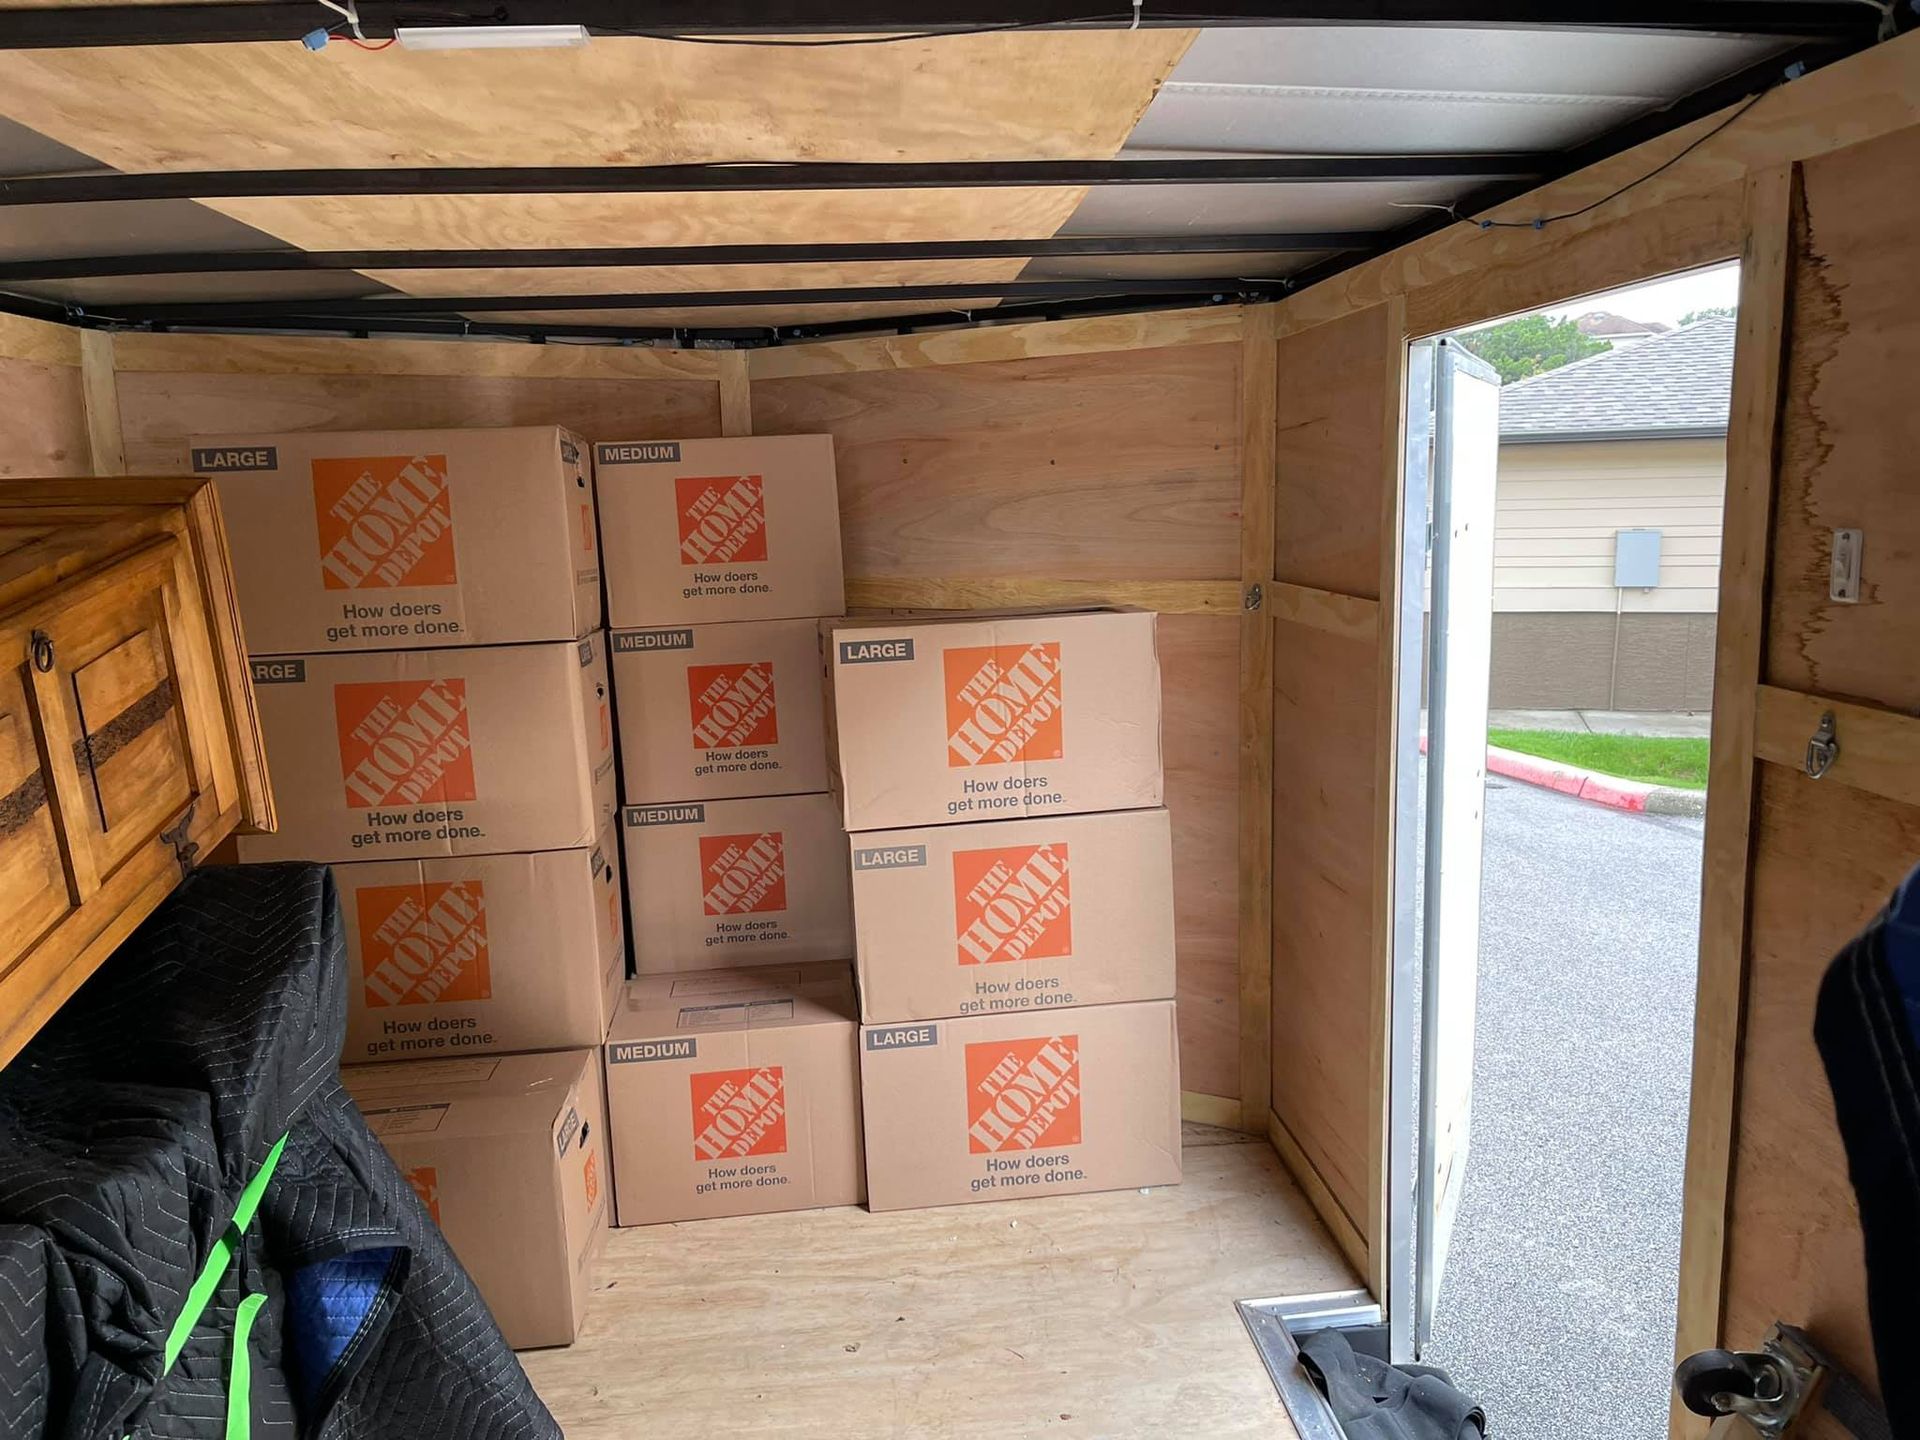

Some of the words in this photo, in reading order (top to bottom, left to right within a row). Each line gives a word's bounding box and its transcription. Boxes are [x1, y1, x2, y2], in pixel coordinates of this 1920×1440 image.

[201, 451, 268, 468] LARGE
[605, 447, 674, 461] MEDIUM
[330, 470, 382, 523] THE
[685, 487, 720, 521] THE
[320, 456, 449, 589] HOME
[681, 476, 763, 564] HOME
[715, 508, 765, 563] DEPOT
[375, 504, 453, 587] DEPOT
[683, 587, 703, 598] get
[706, 585, 736, 595] more
[739, 582, 773, 593] done.
[694, 573, 721, 582] How
[725, 571, 758, 581] doers
[343, 603, 385, 619] How
[390, 601, 441, 617] doers
[326, 624, 357, 642] get
[362, 622, 414, 637] more
[419, 618, 465, 634] done.
[620, 634, 686, 648] MEDIUM
[847, 643, 906, 660] LARGE
[252, 664, 296, 680] RGE
[956, 659, 1004, 707] THE
[693, 663, 773, 747] HOME
[698, 674, 734, 707] THE
[949, 643, 1062, 766] HOME
[351, 696, 402, 745] THE
[727, 694, 775, 747] DEPOT
[993, 687, 1062, 763] DEPOT
[345, 678, 467, 807] HOME
[706, 752, 732, 761] How
[736, 749, 768, 759] doers
[397, 726, 471, 804] DEPOT
[695, 764, 715, 775] get
[717, 762, 747, 772] more
[750, 760, 782, 770] done.
[964, 779, 998, 793] How
[1003, 776, 1048, 789] doers
[367, 812, 408, 825] How
[413, 809, 463, 823] doers
[633, 809, 698, 822] MEDIUM
[947, 798, 974, 814] get
[978, 795, 1018, 810] more
[1023, 792, 1066, 806] done.
[351, 832, 380, 848] get
[385, 829, 431, 842] more
[436, 824, 486, 839] done.
[703, 832, 783, 915] HOME
[709, 843, 745, 876] THE
[861, 850, 919, 865] LARGE
[737, 861, 785, 912] DEPOT
[965, 860, 1013, 907] THE
[958, 843, 1069, 963] HOME
[374, 897, 426, 944] THE
[716, 922, 743, 932] How
[746, 920, 777, 930] doers
[1002, 885, 1070, 960] DEPOT
[366, 881, 483, 1006] HOME
[705, 935, 725, 946] get
[728, 933, 756, 942] more
[760, 931, 790, 941] done.
[416, 926, 487, 1003] DEPOT
[975, 980, 1010, 994] How
[1015, 977, 1059, 990] doers
[960, 999, 985, 1014] get
[989, 996, 1029, 1009] more
[1034, 992, 1076, 1005] done.
[383, 1020, 422, 1034] How
[427, 1017, 476, 1031] doers
[873, 1030, 929, 1045] LARGE
[367, 1041, 395, 1055] get
[400, 1037, 445, 1050] more
[450, 1032, 497, 1046] done.
[617, 1042, 690, 1058] MEDIUM
[978, 1052, 1024, 1095] THE
[701, 1080, 738, 1117] THE
[968, 1036, 1079, 1153] HOME
[694, 1067, 784, 1159] HOME
[731, 1099, 785, 1157] DEPOT
[1014, 1075, 1080, 1149] DEPOT
[558, 1114, 577, 1150] LARGE
[709, 1167, 737, 1178] How
[740, 1164, 776, 1175] doers
[986, 1157, 1020, 1171] How
[1026, 1154, 1069, 1167] doers
[696, 1180, 716, 1192] get
[720, 1178, 753, 1189] more
[756, 1175, 790, 1186] done.
[971, 1176, 997, 1191] get
[1001, 1173, 1039, 1186] more
[1045, 1169, 1087, 1182] done.
